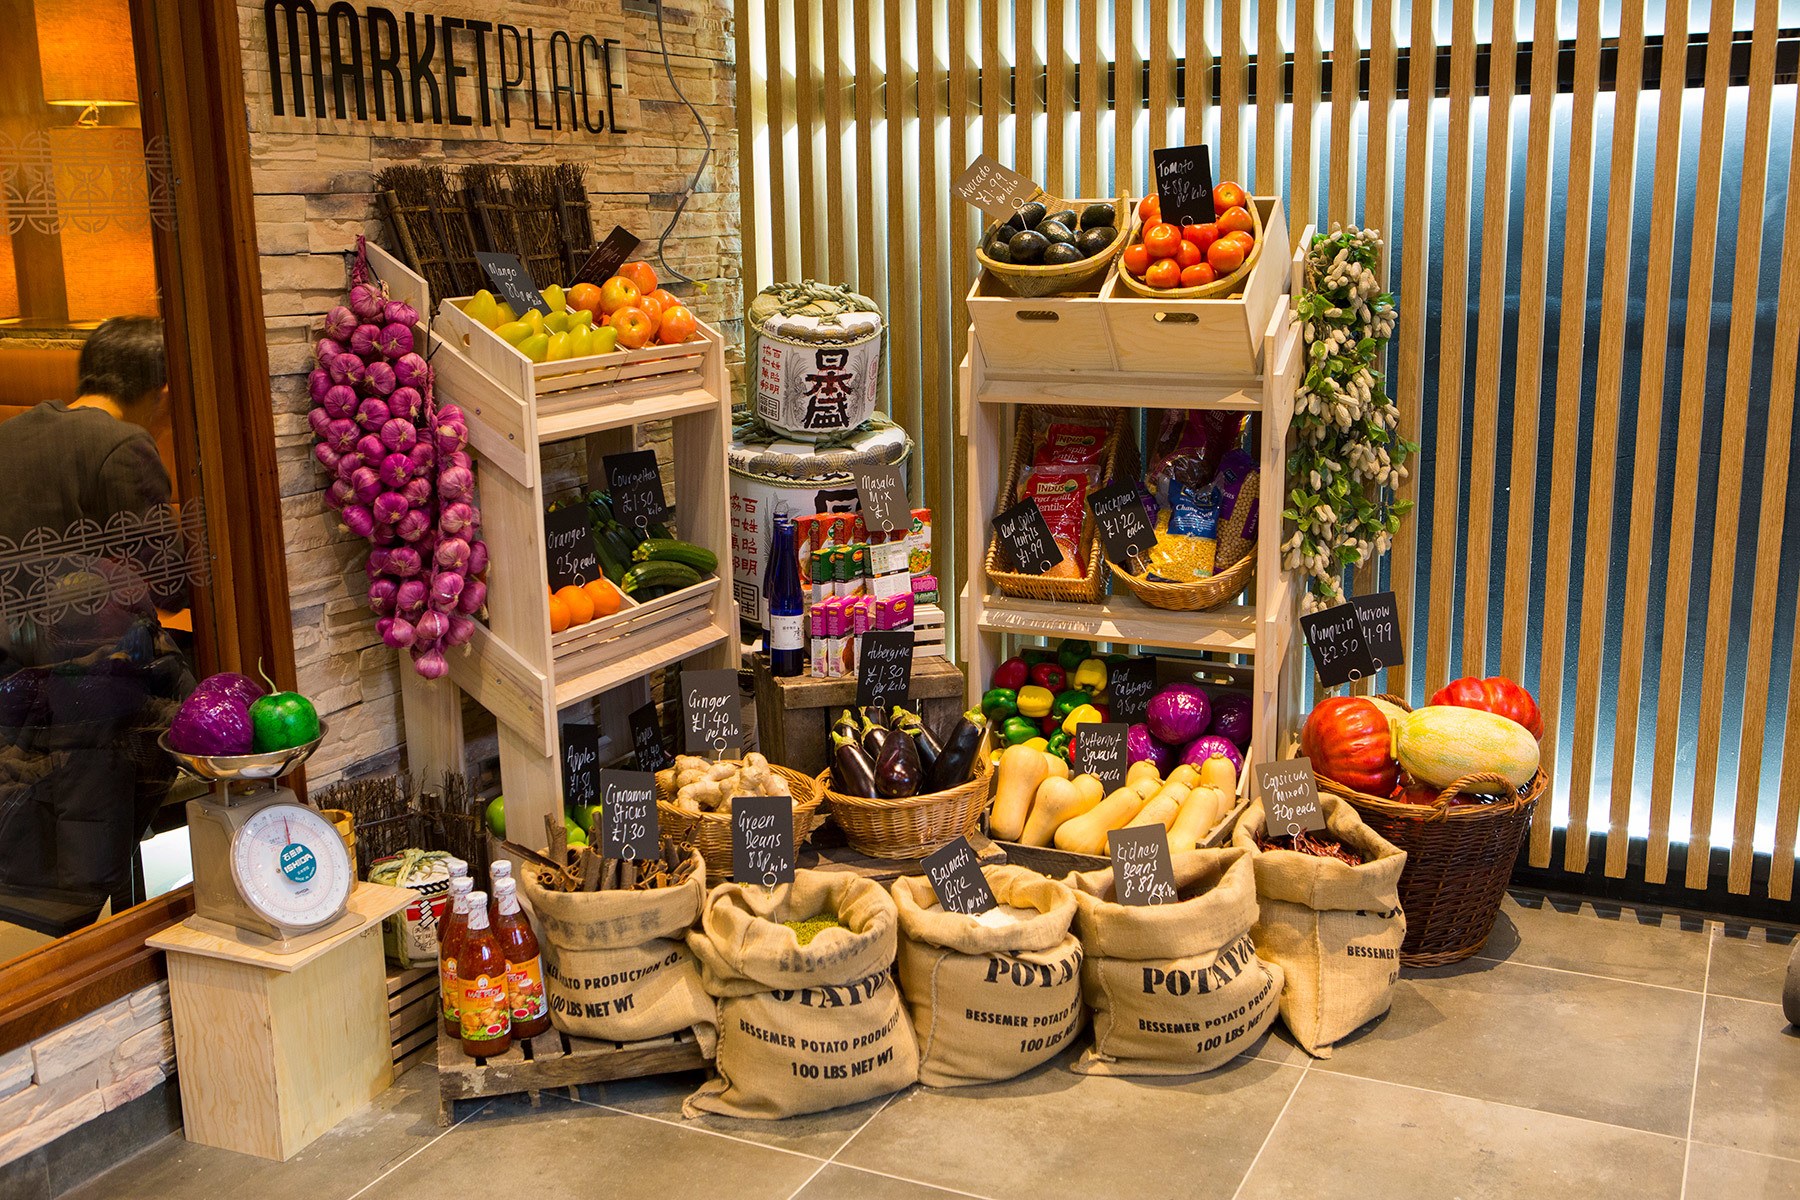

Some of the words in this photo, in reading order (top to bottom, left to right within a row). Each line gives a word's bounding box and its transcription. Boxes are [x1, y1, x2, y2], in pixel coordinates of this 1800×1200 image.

[264, 0, 628, 134] MARKETPLACE
[1157, 159, 1194, 177] Tomato
[958, 165, 990, 197] Avocado
[488, 262, 517, 281] Mango
[1037, 482, 1065, 493] INDUS
[688, 689, 732, 713] Ginger
[691, 712, 729, 733] £1.40
[605, 784, 652, 806] Cinnamon
[738, 810, 775, 830] Green
[283, 853, 314, 874] ISHIDA
[1347, 945, 1395, 960] BESSEMER
[584, 962, 661, 990] PRODUCTION
[664, 951, 683, 966] CO.
[566, 997, 583, 1018] LBS
[585, 1001, 610, 1018] NET
[613, 993, 635, 1015] WT
[965, 1008, 1028, 1028] BESSEMER
[1033, 1008, 1069, 1028] POTATO
[1139, 1018, 1201, 1034] BESSEMER
[1205, 1006, 1246, 1029] POTATO
[739, 1018, 796, 1049] BESSEMER
[801, 1038, 849, 1053] POTATO
[1020, 1039, 1044, 1053] 100
[1045, 1030, 1064, 1048] LBS
[1196, 1035, 1222, 1053] 100
[1224, 1025, 1245, 1045] LBS
[791, 1062, 820, 1079] 100
[823, 1065, 848, 1079] LBS
[851, 1057, 875, 1077] NET
[877, 1046, 894, 1067] WT
